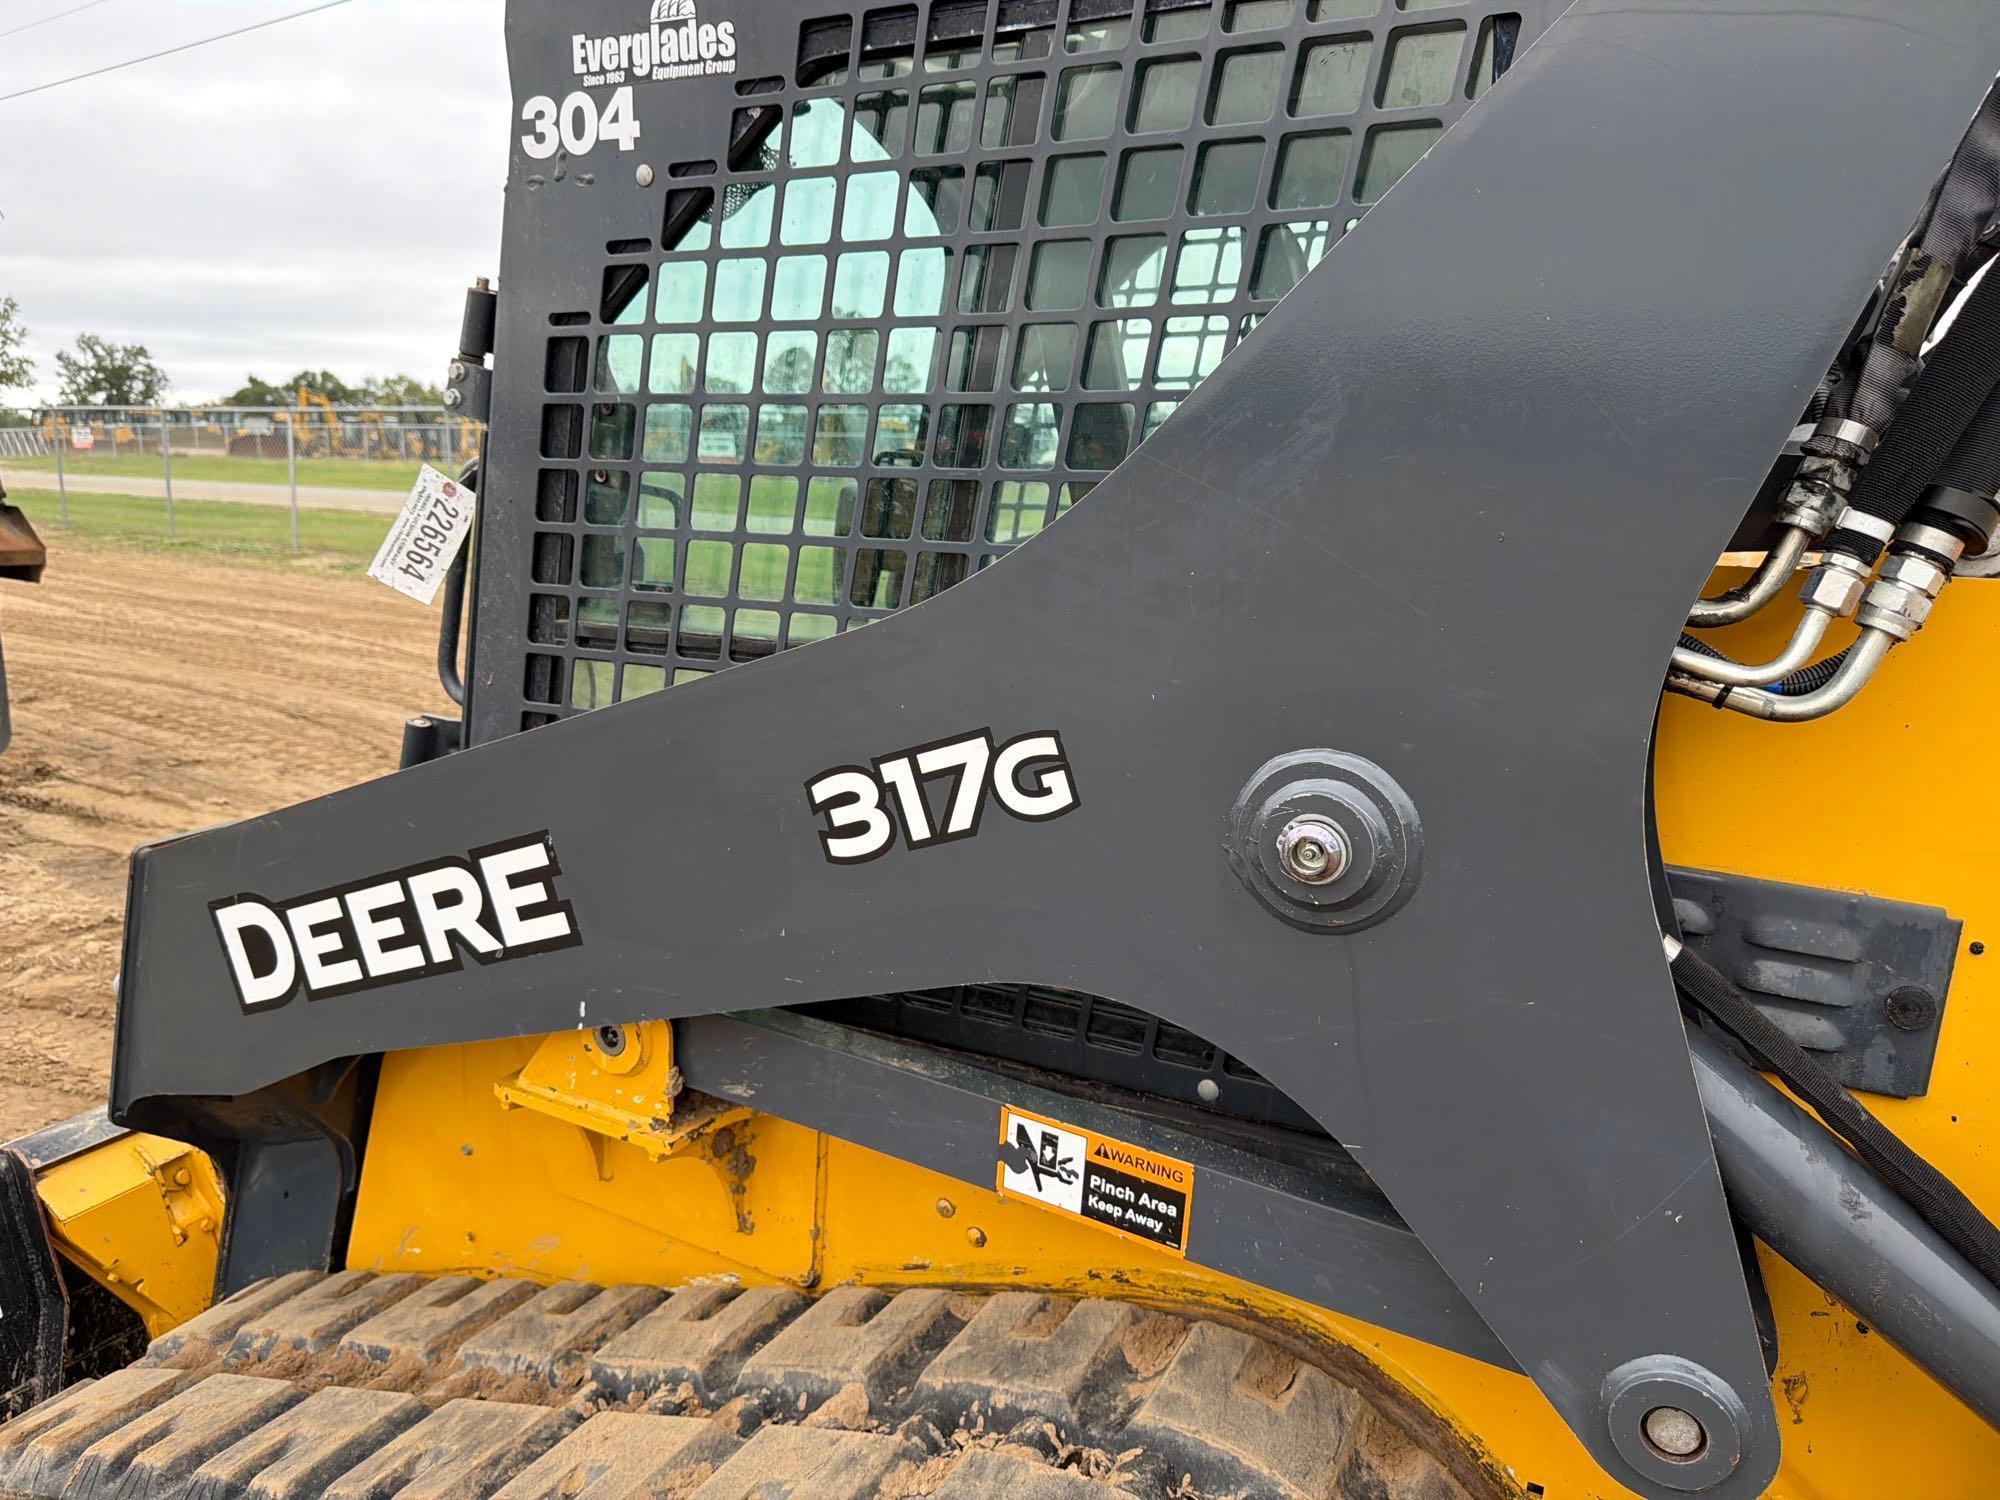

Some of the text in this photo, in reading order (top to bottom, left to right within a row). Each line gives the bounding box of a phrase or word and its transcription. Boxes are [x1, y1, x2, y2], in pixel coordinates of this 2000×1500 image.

[572, 19, 736, 77] Everglades
[652, 58, 735, 81] Equipment Group
[583, 71, 626, 87] Since 1963
[521, 86, 640, 159] 304
[398, 497, 460, 583] 226564
[811, 737, 1073, 858] 317G
[215, 842, 571, 1004] DEERE
[1110, 1149, 1183, 1183] WARNING
[1088, 1194, 1163, 1233] Keep Away
[1090, 1175, 1177, 1218] Pinch Area
